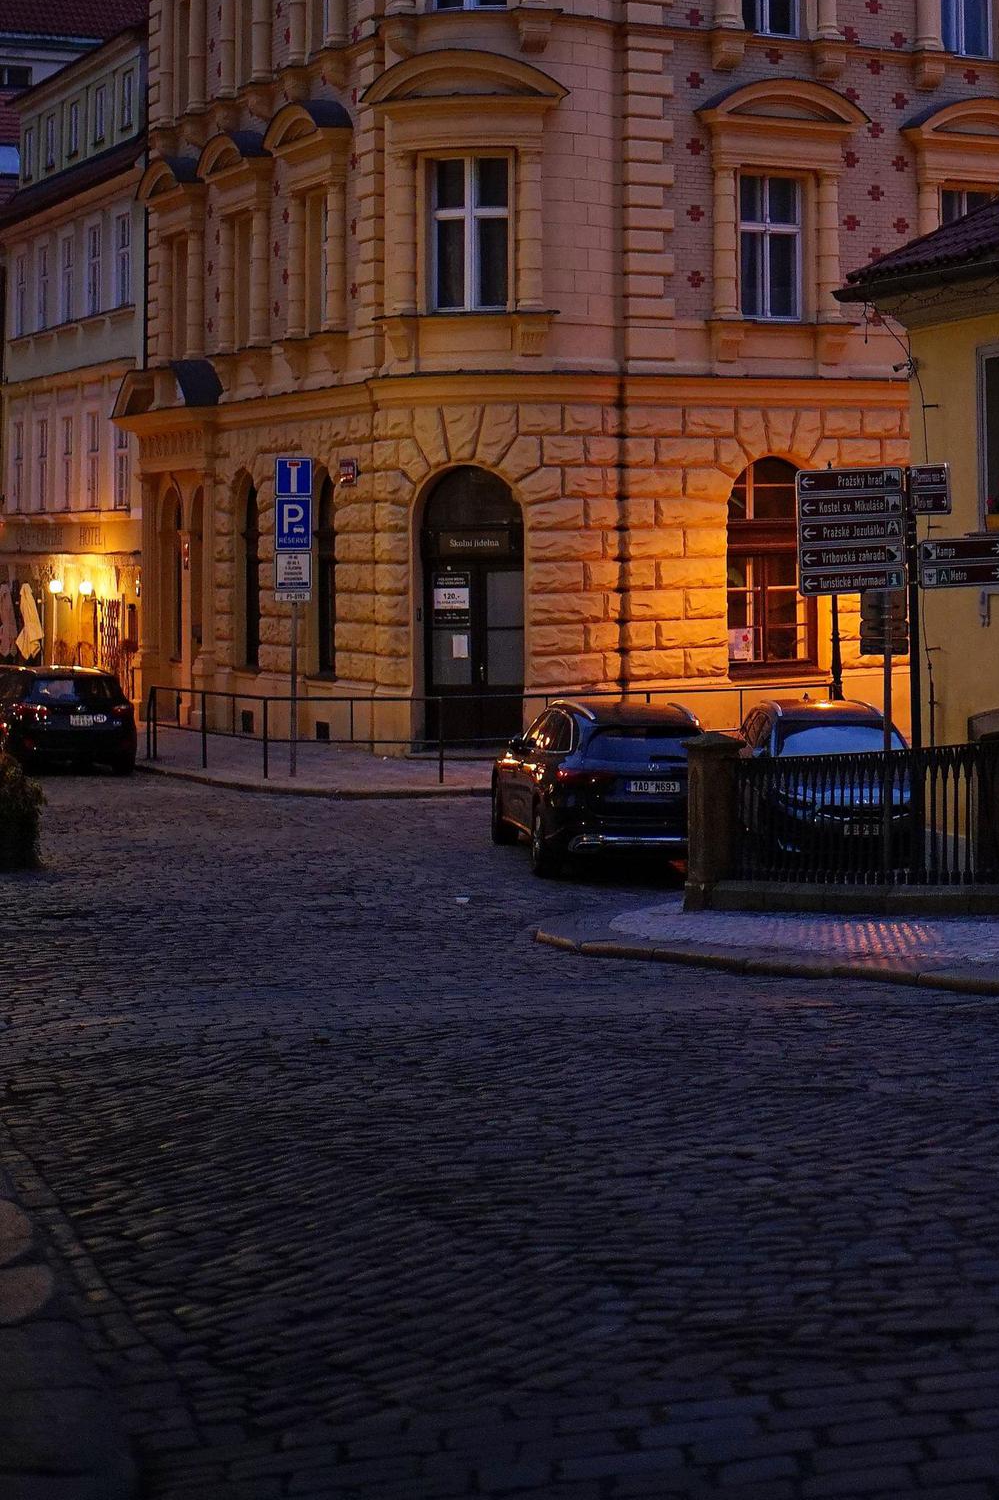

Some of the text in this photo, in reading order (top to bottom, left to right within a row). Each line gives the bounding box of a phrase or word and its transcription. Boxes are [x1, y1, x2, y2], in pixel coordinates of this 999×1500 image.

[837, 472, 883, 488] Pražský hrad
[819, 499, 885, 513] Kostel sv. Mikuláše
[284, 504, 304, 534] P
[79, 526, 102, 546] HOTEL
[823, 524, 885, 538] Pražské Jezulátko
[821, 548, 886, 563] Vrtbovská zahrada
[936, 547, 956, 559] Kampa
[950, 569, 968, 581] Metro
[820, 576, 852, 589] Turistické
